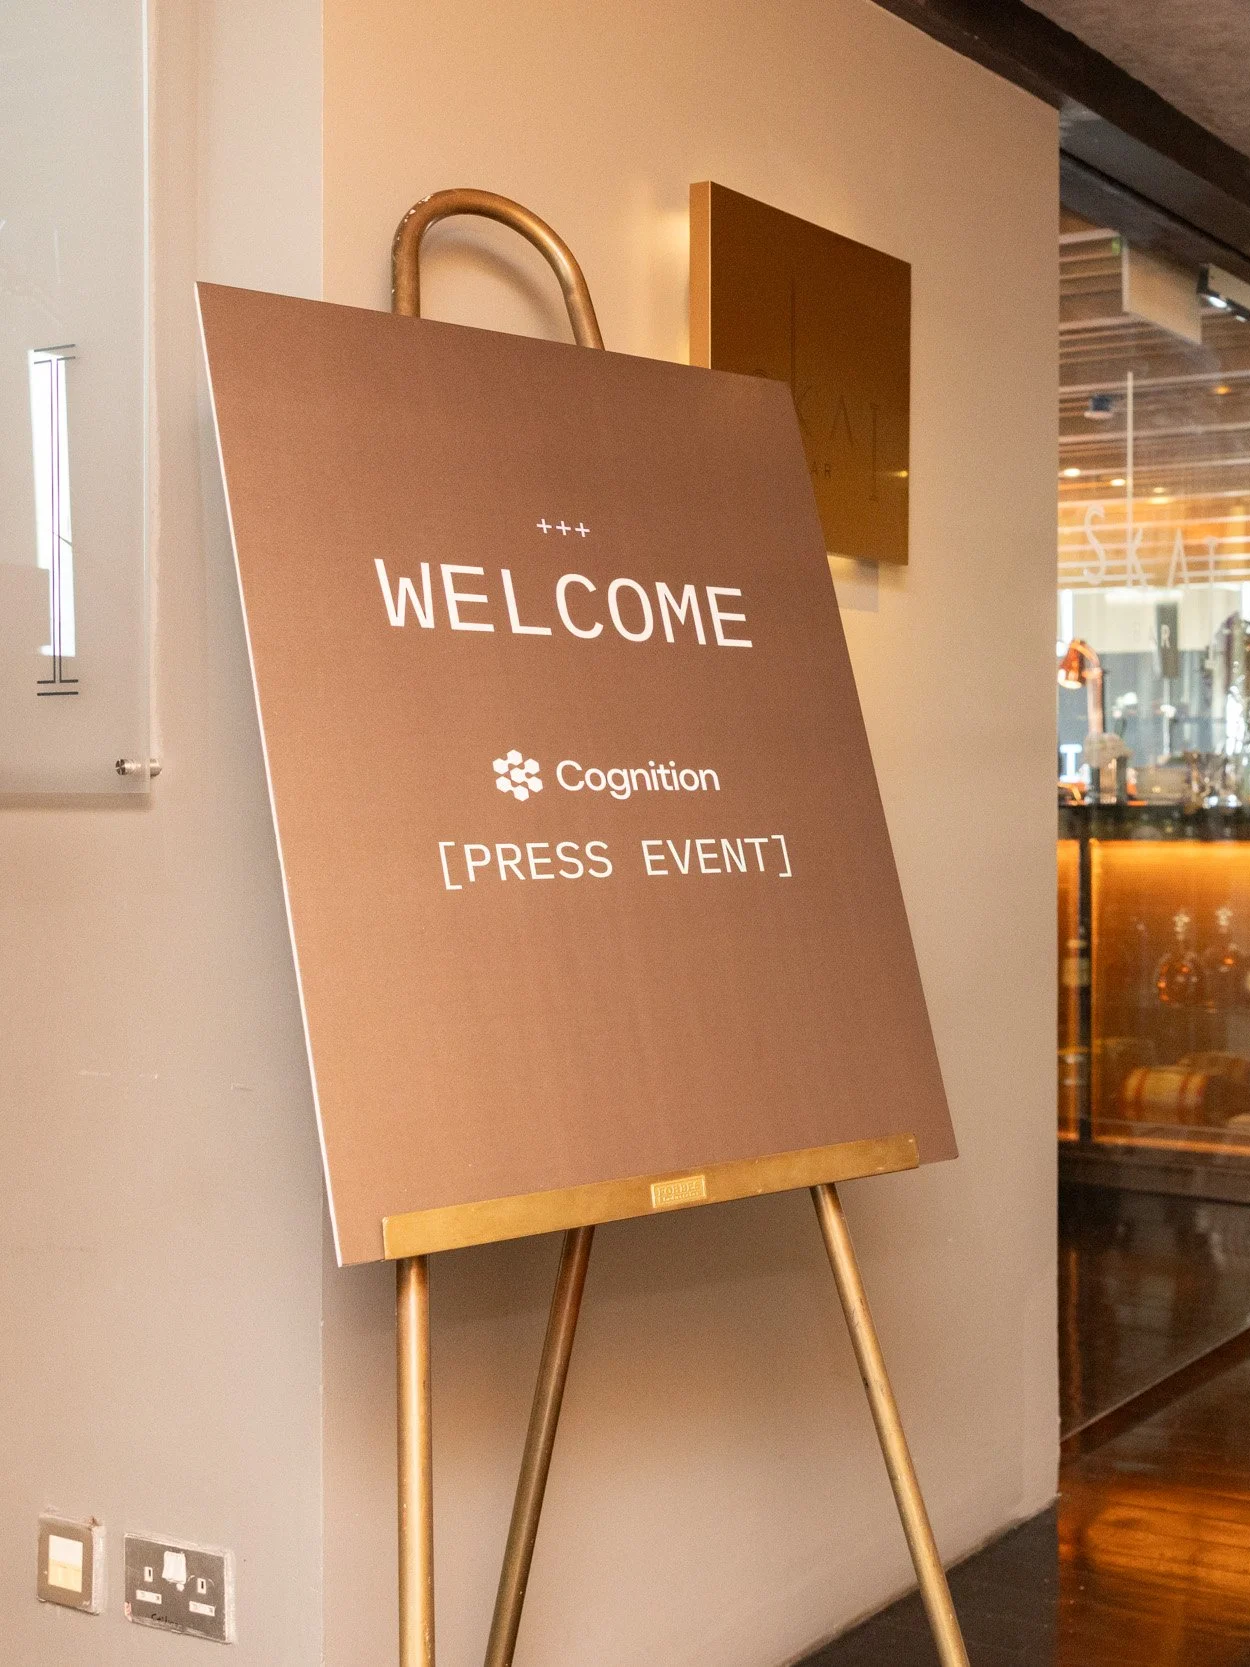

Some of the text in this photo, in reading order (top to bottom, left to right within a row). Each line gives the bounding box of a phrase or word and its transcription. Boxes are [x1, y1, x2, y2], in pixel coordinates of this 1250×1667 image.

[374, 558, 754, 648] WELCOME
[556, 760, 721, 799] Cognition
[438, 834, 793, 890] [PRESS EVENT]
